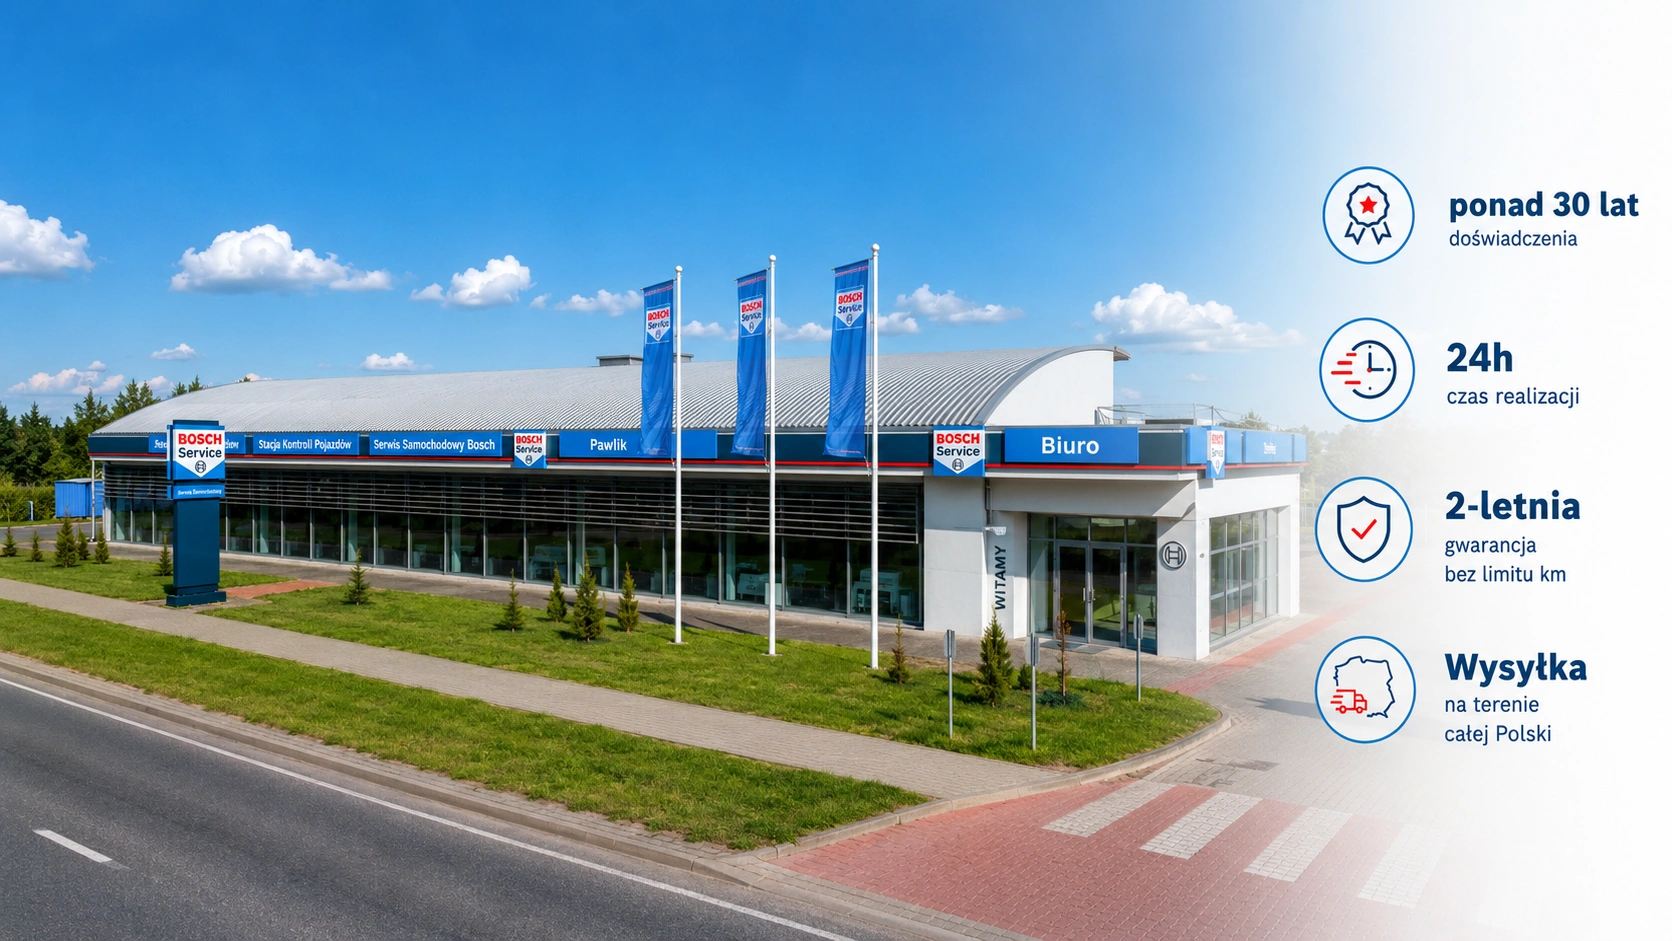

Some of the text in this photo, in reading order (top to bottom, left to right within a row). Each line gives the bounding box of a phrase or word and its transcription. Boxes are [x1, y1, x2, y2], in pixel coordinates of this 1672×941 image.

[178, 433, 222, 445] BOSCH
[516, 435, 543, 444] BOSCH
[590, 437, 628, 452] Pawlik
[936, 433, 980, 444] BOSCH
[374, 439, 495, 453] Serwis Samochodowy Bosch
[516, 445, 543, 454] Service
[936, 445, 980, 457] Service
[1041, 436, 1100, 455] Biuro
[178, 447, 222, 458] Service
[994, 545, 1007, 610] WITAMY
